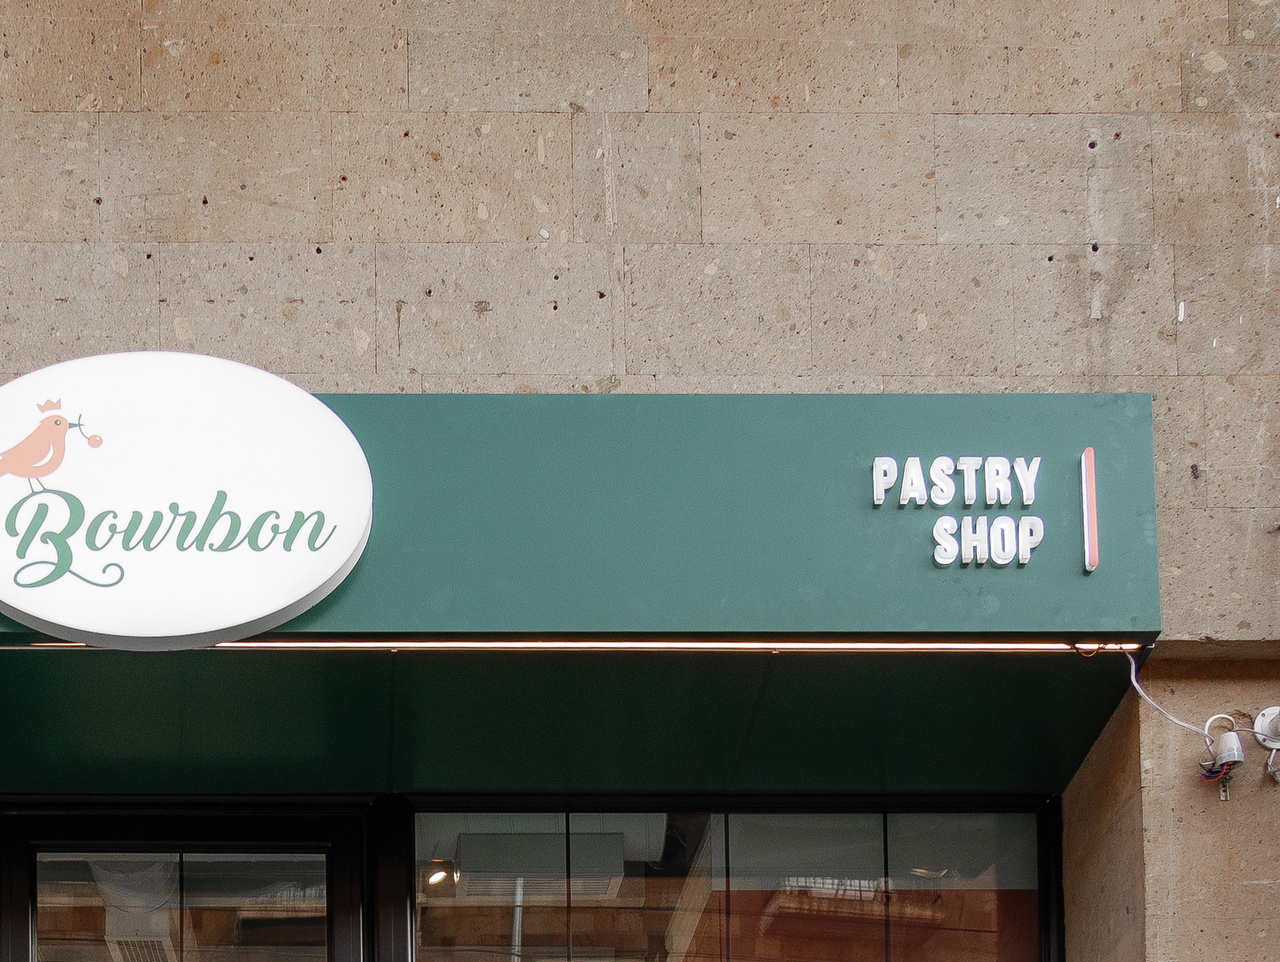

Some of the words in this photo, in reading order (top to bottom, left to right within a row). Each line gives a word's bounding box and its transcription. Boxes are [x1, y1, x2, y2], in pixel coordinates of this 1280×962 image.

[872, 456, 1042, 506] PASTRY
[5, 489, 337, 588] Bourbon
[932, 515, 1045, 565] SHOP
